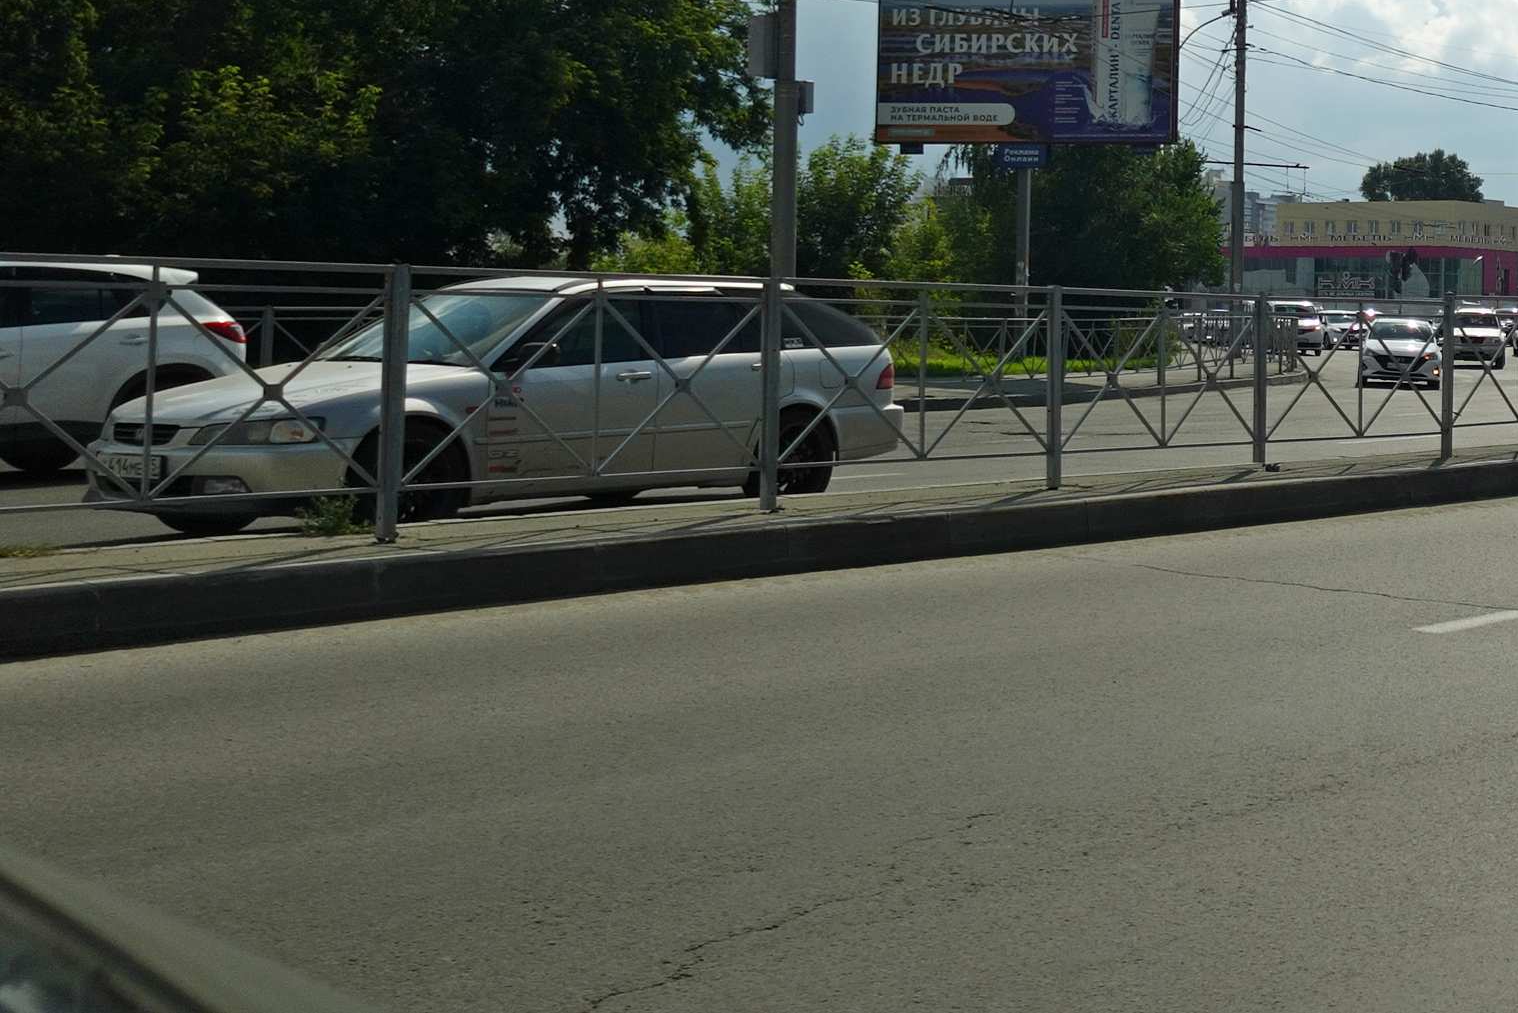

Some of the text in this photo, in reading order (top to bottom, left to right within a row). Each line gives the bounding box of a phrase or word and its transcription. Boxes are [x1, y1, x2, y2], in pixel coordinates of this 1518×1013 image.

[892, 8, 921, 26] ИЗ
[915, 32, 1080, 55] СИБИРСКИХ
[890, 62, 964, 88] НЕДР
[890, 106, 960, 114] ЗУБНАЯ ПАСТА
[890, 113, 999, 122] НА ТЕРМАЛЬНОЙ ВОДЕ
[1330, 235, 1393, 243] МЕБЕЛЬ
